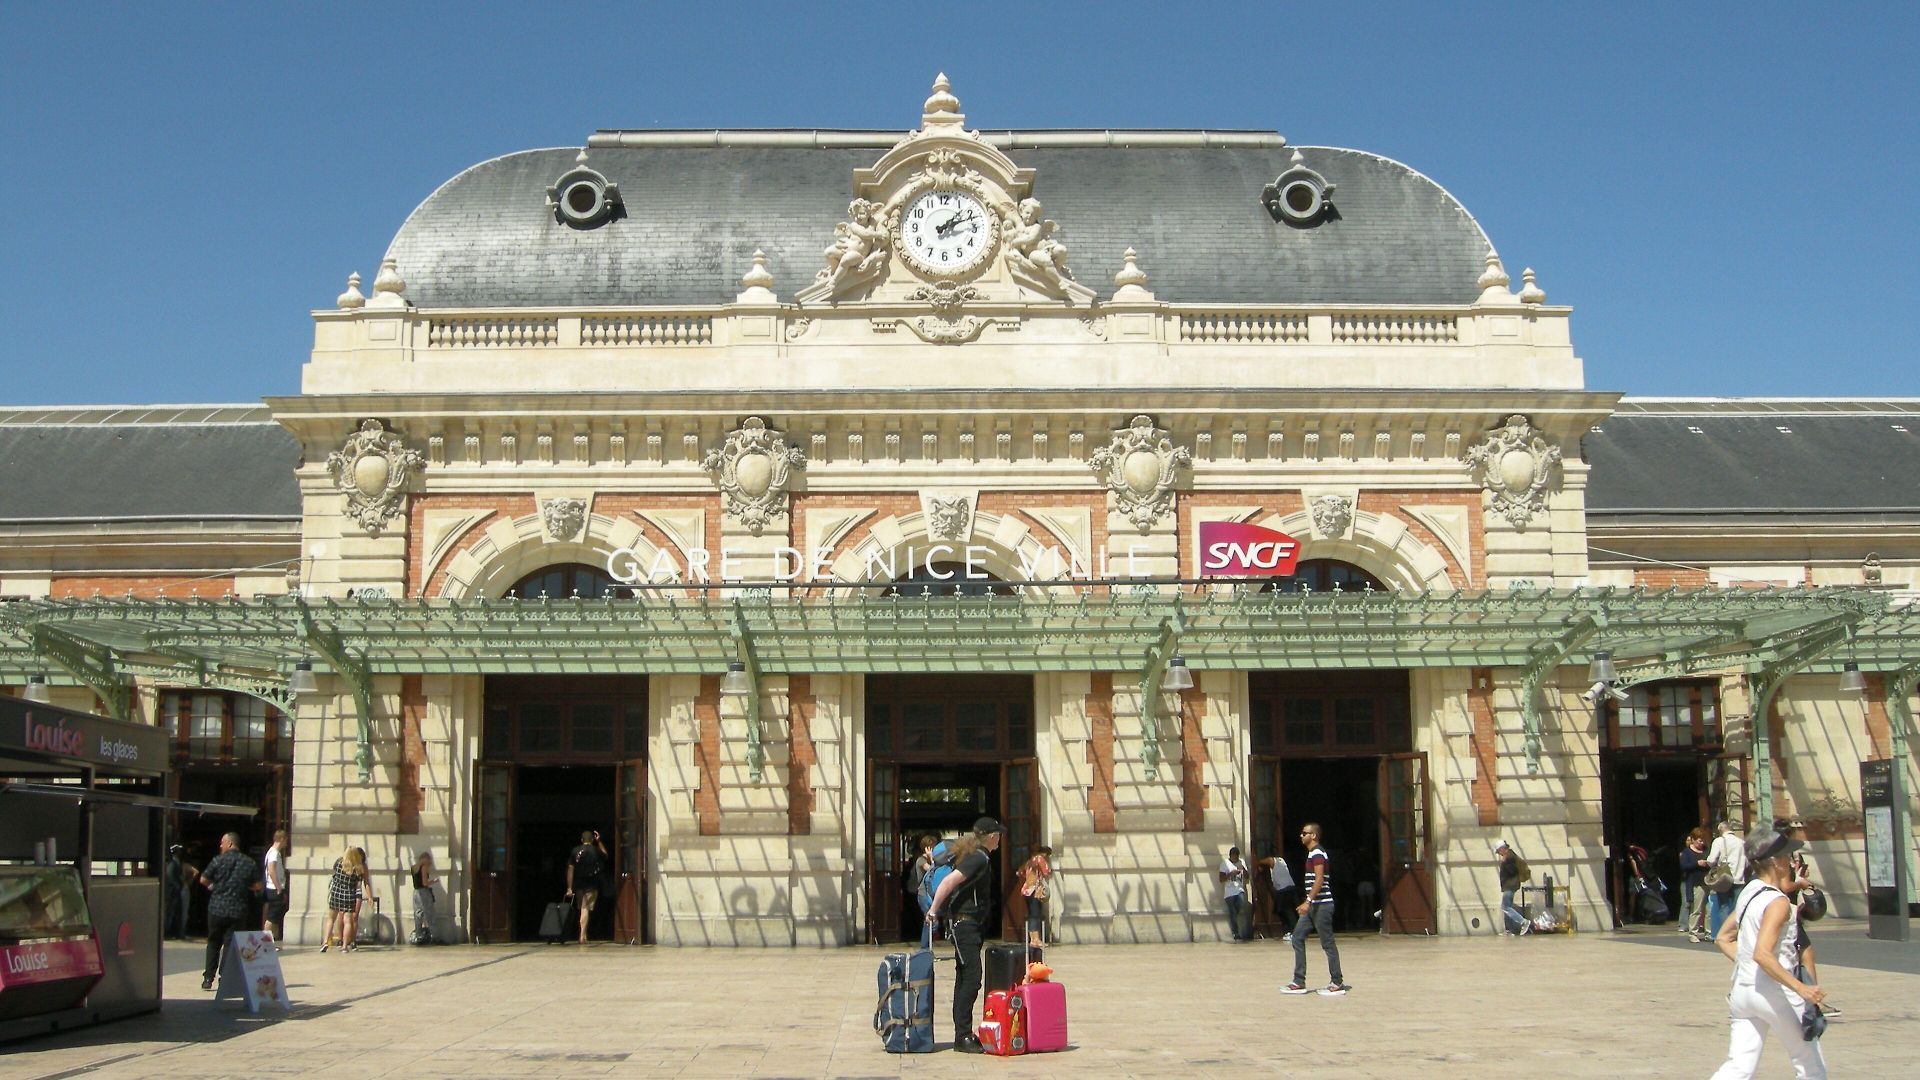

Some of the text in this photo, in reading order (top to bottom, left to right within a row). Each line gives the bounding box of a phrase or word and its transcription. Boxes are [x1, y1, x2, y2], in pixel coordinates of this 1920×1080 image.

[926, 199, 934, 208] 11
[940, 194, 949, 205] 12
[914, 209, 923, 218] 10
[967, 209, 973, 221] 2
[912, 222, 918, 232] 9
[971, 223, 977, 233] 3
[916, 237, 922, 247] 8
[967, 237, 973, 247] 4
[928, 248, 934, 257] 7
[941, 251, 948, 261] 6
[956, 248, 963, 257] 5
[1204, 542, 1296, 569] SNCF
[606, 544, 1152, 582] GARE DE NICE VILLE
[100, 735, 138, 762] les glaces
